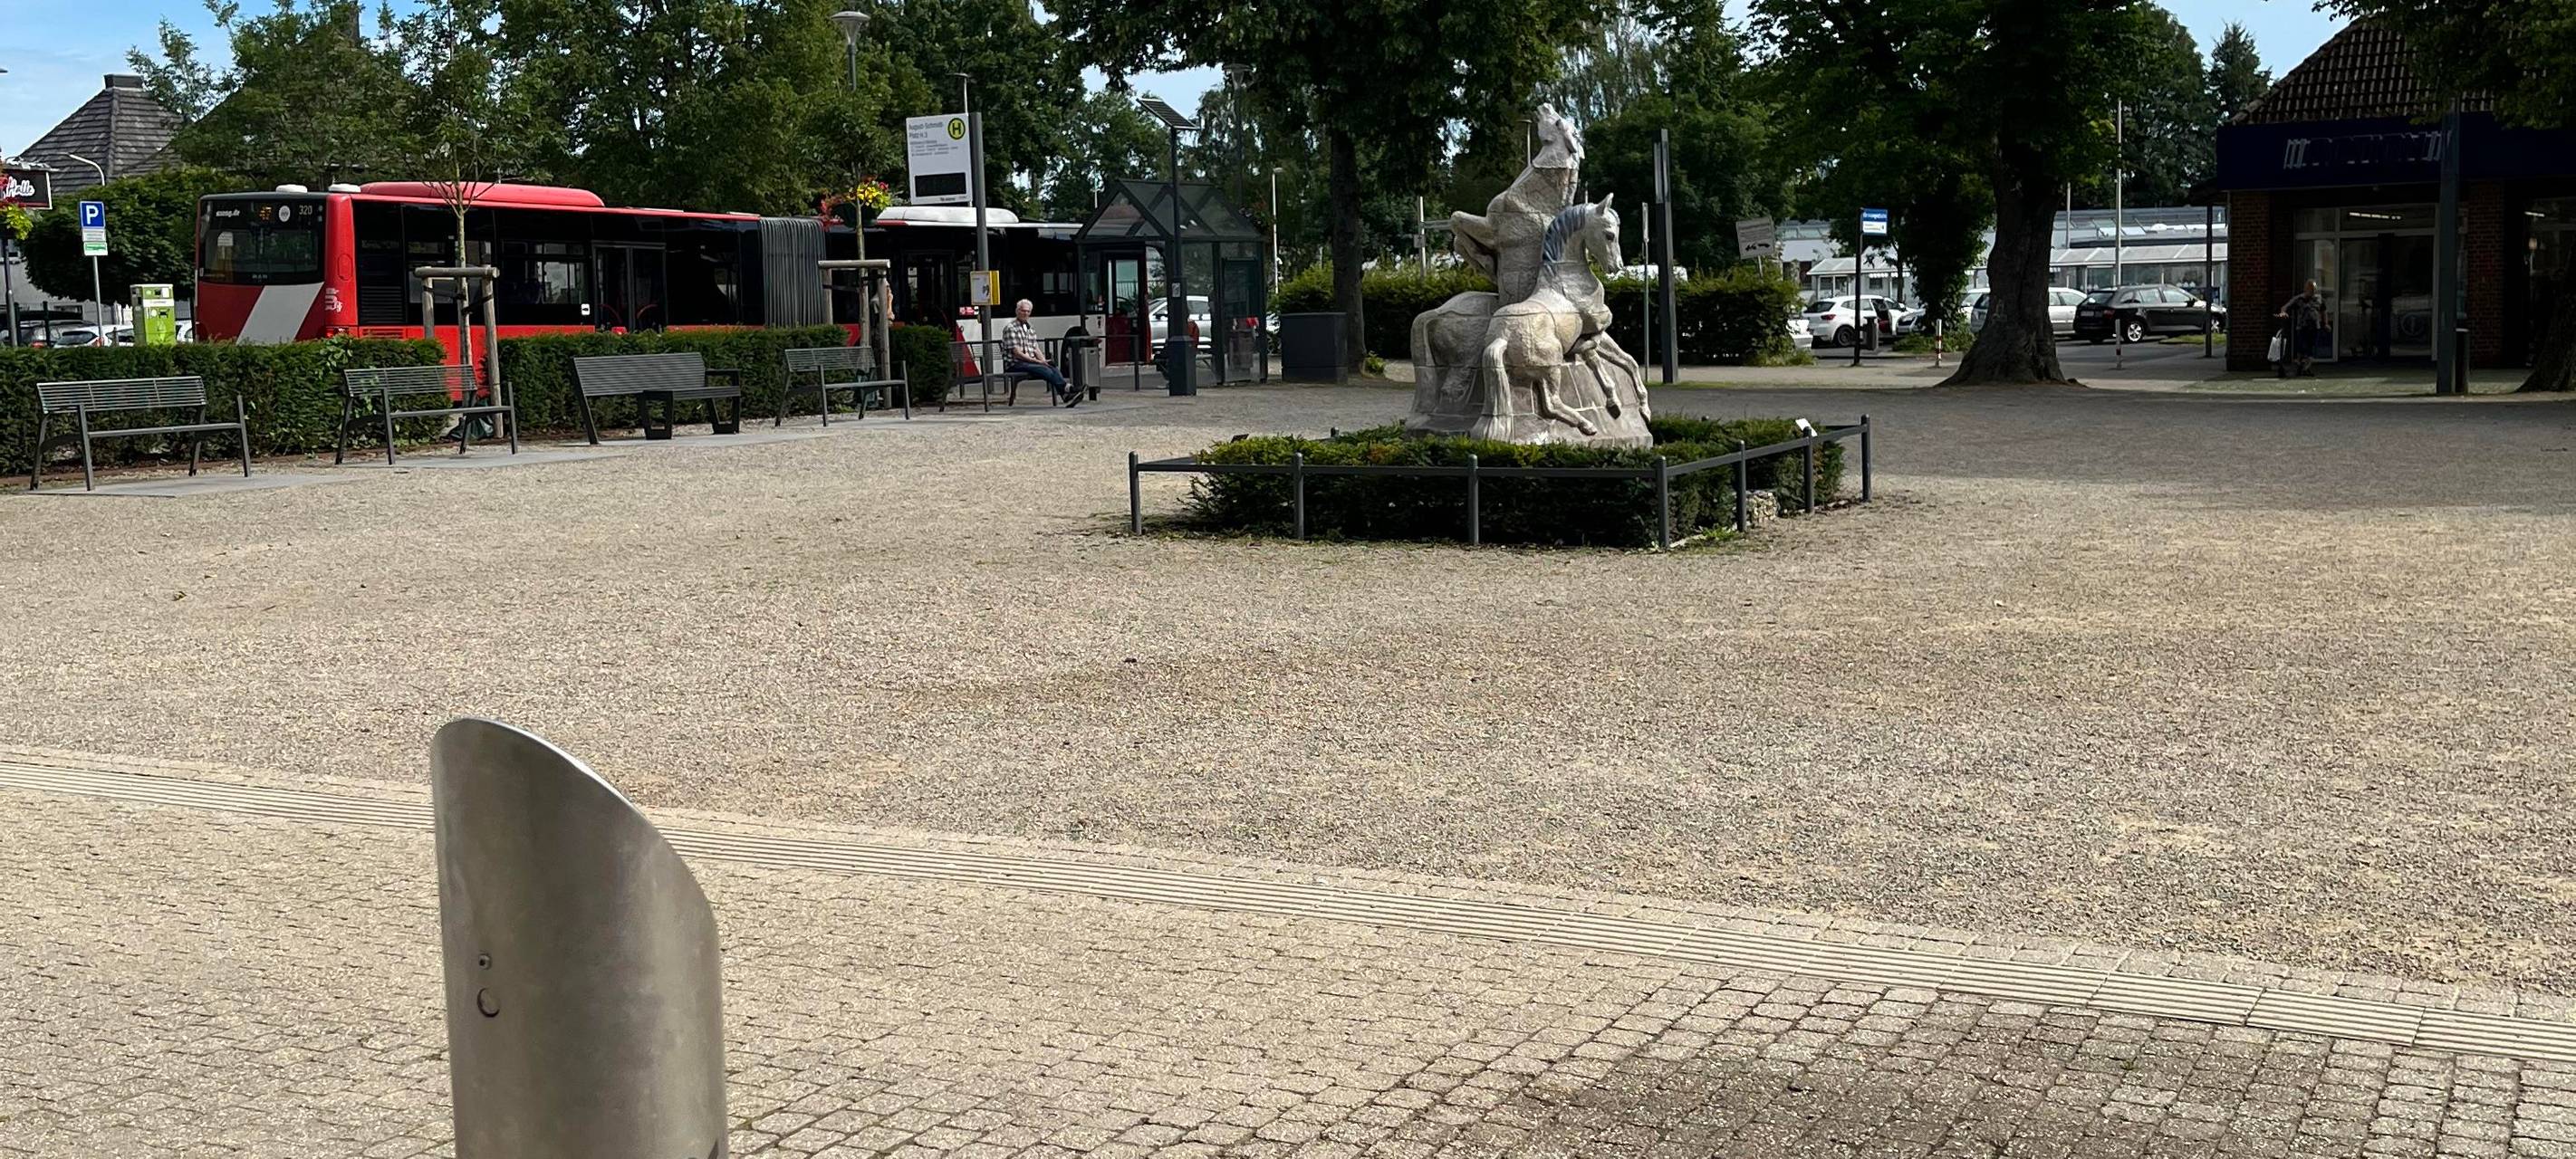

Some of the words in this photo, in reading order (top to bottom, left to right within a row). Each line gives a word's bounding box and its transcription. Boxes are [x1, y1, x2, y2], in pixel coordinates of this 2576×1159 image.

[952, 122, 962, 136] H
[86, 205, 99, 225] P
[298, 205, 313, 216] 320
